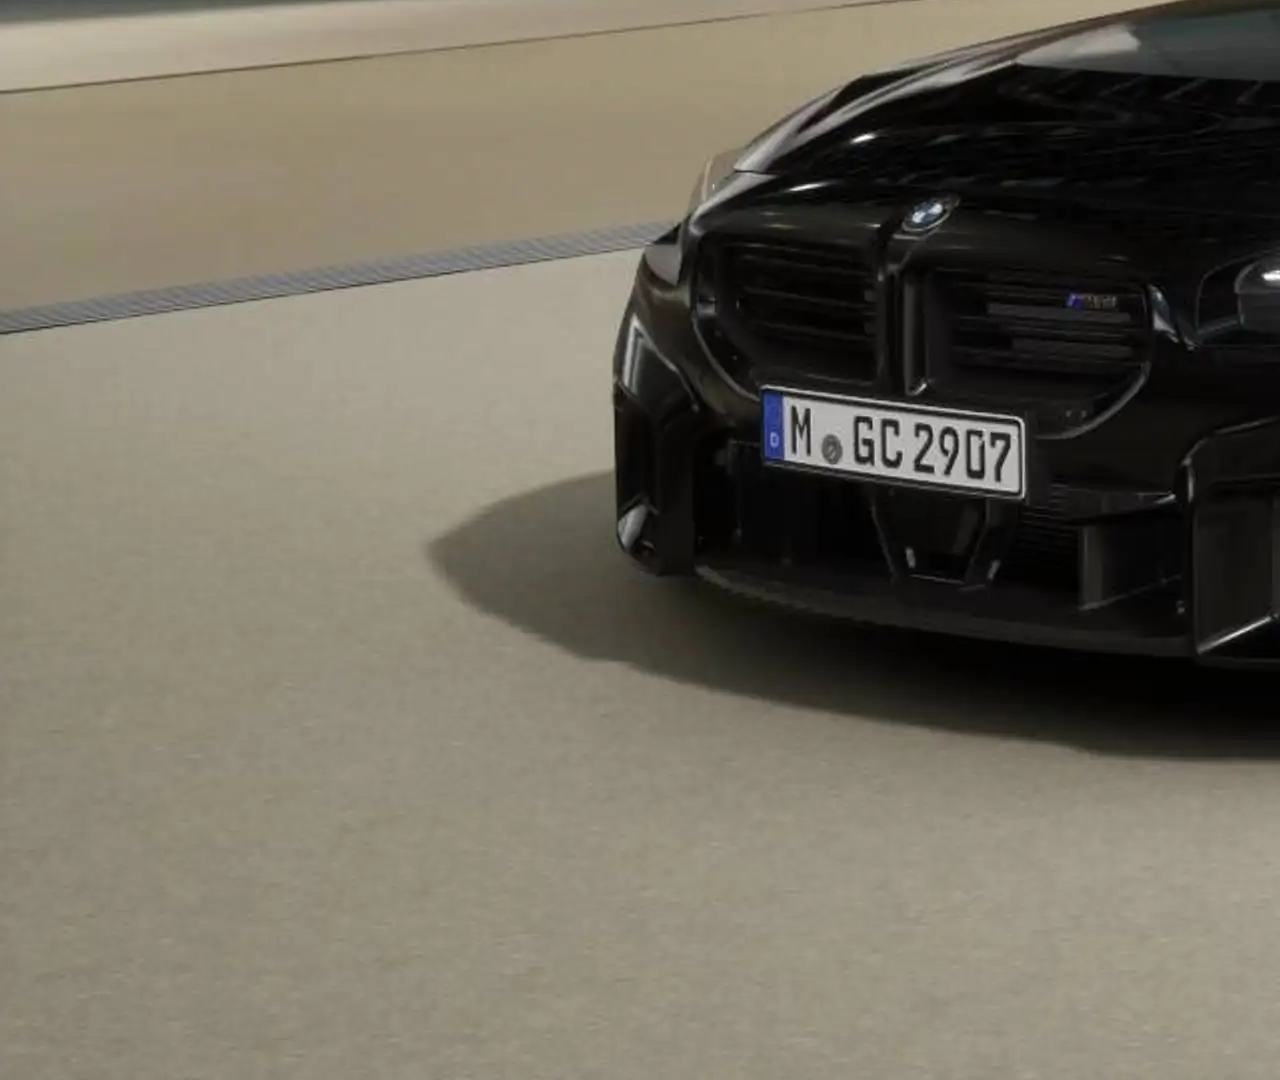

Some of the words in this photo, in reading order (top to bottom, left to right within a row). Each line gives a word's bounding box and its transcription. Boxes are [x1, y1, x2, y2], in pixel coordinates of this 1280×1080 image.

[769, 431, 780, 448] D
[791, 405, 812, 457] M
[853, 416, 903, 469] GC
[913, 422, 1012, 482] 2907
